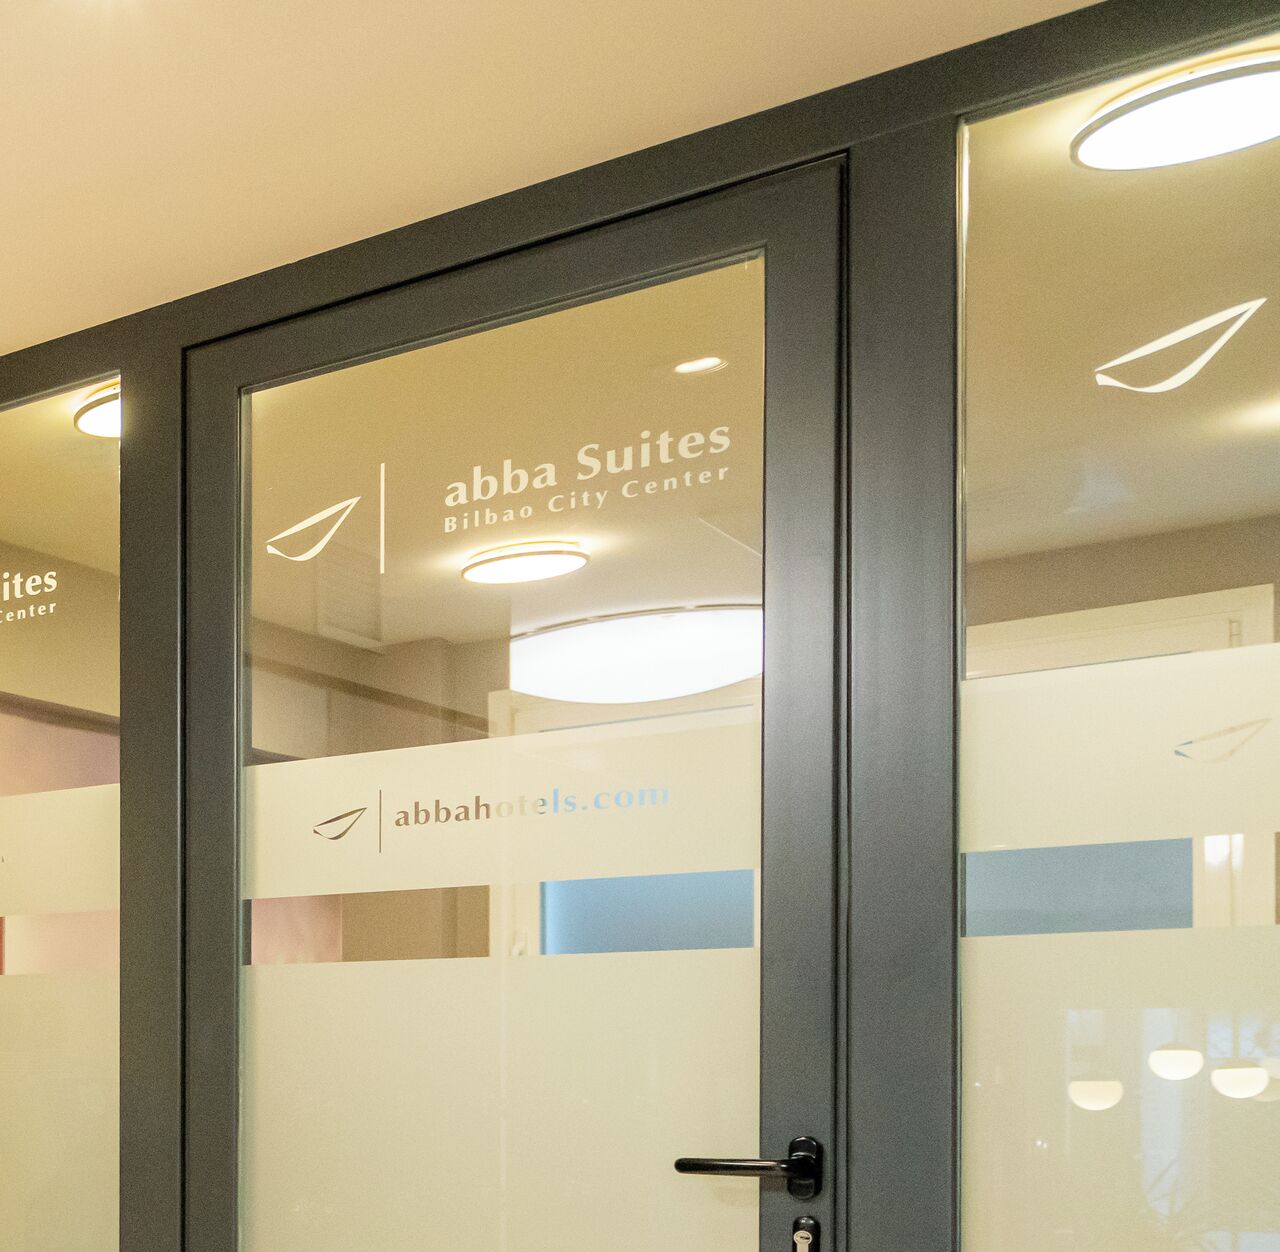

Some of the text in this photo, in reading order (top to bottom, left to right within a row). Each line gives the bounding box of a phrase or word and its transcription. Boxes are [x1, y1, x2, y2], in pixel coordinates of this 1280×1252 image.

[444, 426, 730, 507] abba Suites
[444, 467, 729, 533] Bilbao City Center
[394, 787, 670, 827] abbahotels.com
